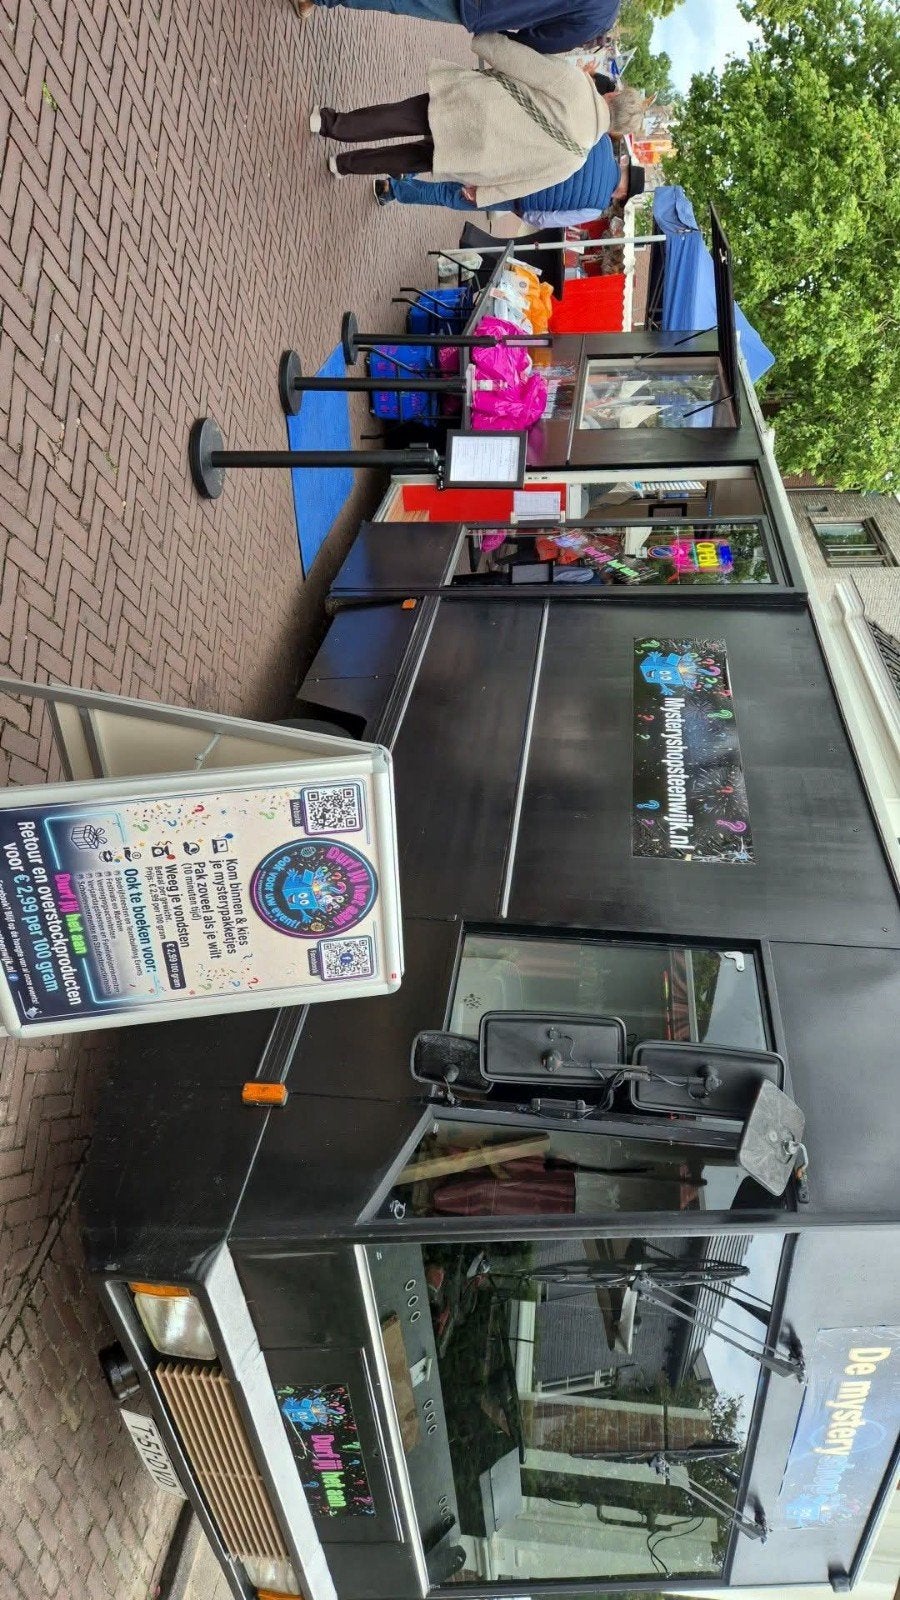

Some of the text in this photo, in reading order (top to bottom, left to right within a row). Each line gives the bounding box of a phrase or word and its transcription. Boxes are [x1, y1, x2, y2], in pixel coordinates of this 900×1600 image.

[696, 543, 720, 566] OPEN
[660, 697, 695, 850] Mysteryshopsteenwijk.nl
[154, 866, 166, 885] Betaal
[226, 858, 238, 880] Kom
[54, 874, 76, 899] Durf
[157, 886, 167, 896] per
[181, 863, 202, 920] (10 minuten tijd)
[265, 872, 278, 892] voor
[151, 903, 161, 913] per
[164, 864, 190, 948] Weeg je vondsten
[209, 860, 238, 954] je mysterypakketjes
[230, 882, 243, 915] binnen
[2, 842, 60, 992] voor € 2,99 per 100 gram
[16, 822, 82, 1006] Retour en overstockproducten
[65, 914, 84, 932] het
[124, 868, 156, 972] Ook te boeken voor:
[194, 862, 222, 960] Pak zoveel als je wilt
[70, 934, 88, 954] aan
[237, 926, 249, 946] kies
[844, 1346, 891, 1376] De
[311, 1434, 340, 1458] Durf
[322, 1472, 346, 1488] het
[326, 1490, 346, 1507] aan
